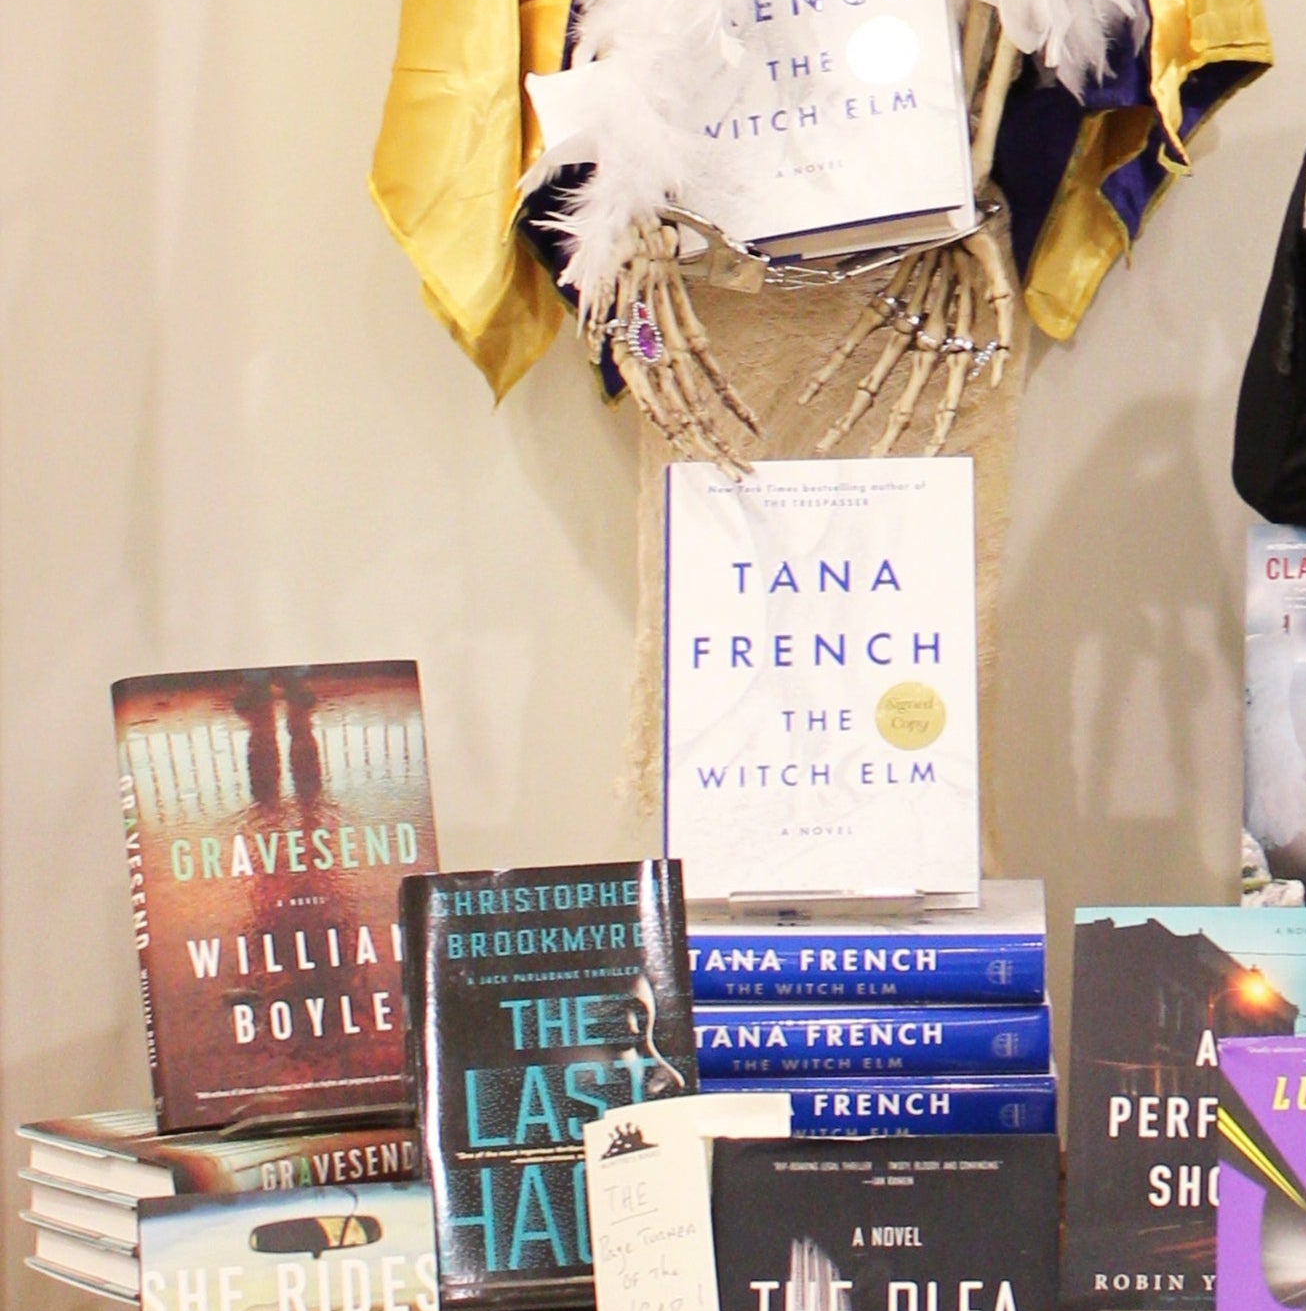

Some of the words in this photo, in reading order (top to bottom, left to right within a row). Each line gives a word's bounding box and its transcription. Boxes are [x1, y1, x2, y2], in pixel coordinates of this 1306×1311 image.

[766, 50, 834, 82] THE
[844, 88, 919, 120] ELM
[732, 559, 902, 594] TANA
[692, 631, 941, 669] FRENCH
[781, 708, 853, 733] THE
[697, 764, 831, 789] WITCH
[860, 761, 937, 785] ELM
[800, 825, 855, 837] NOVEL
[119, 774, 152, 952] GRAVESEND
[170, 821, 419, 883] GRAVESEND
[687, 948, 782, 973] TANA
[800, 947, 938, 973] FRENCH
[725, 982, 764, 996] THE
[774, 981, 845, 996] WITCH
[856, 981, 898, 996] ELM
[233, 992, 393, 1045] BOYLE
[500, 994, 608, 1051] THE
[693, 1024, 789, 1049] TANA
[806, 1022, 944, 1048] FRENCH
[1195, 1029, 1219, 1068] A
[732, 1058, 771, 1072] THE
[782, 1057, 852, 1071] WITCH
[863, 1056, 904, 1070] ELM
[464, 1056, 660, 1148] LAST
[813, 1092, 951, 1118] FRENCH
[261, 1139, 416, 1192] GRAVESEND
[602, 1181, 649, 1216] THE
[852, 1226, 865, 1247] A
[870, 1226, 923, 1247] NOVEL
[1094, 1273, 1186, 1291] ROBIN
